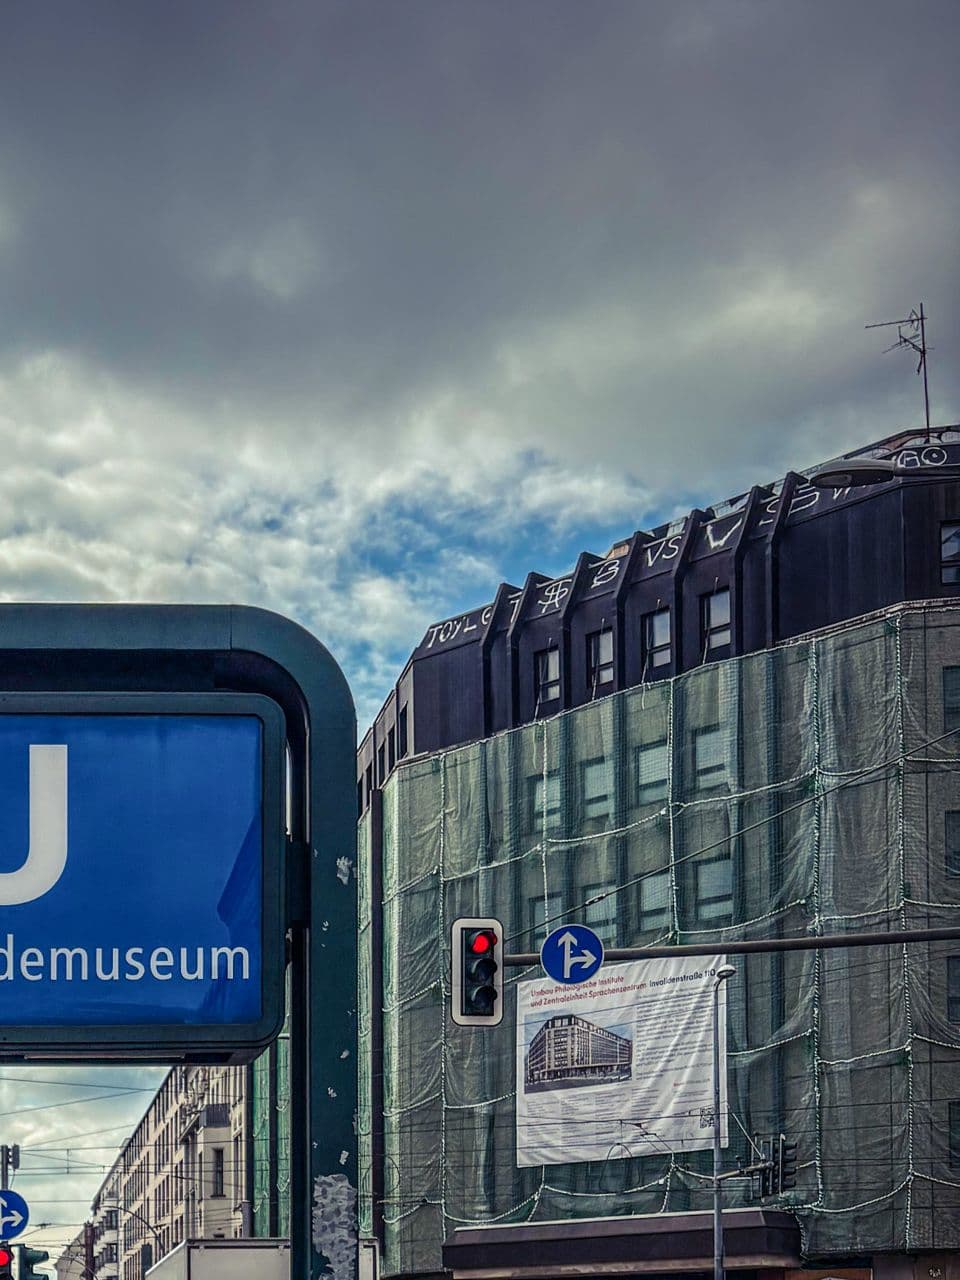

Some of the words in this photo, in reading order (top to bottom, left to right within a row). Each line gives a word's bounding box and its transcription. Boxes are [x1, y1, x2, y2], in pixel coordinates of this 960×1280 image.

[555, 981, 597, 993] Philologische
[598, 975, 625, 985] Institute
[649, 971, 703, 988] Invalidenstraße
[530, 1000, 543, 1008] und
[543, 993, 588, 1005] Zentraleinheit
[588, 982, 647, 999] Sprachenzentrum
